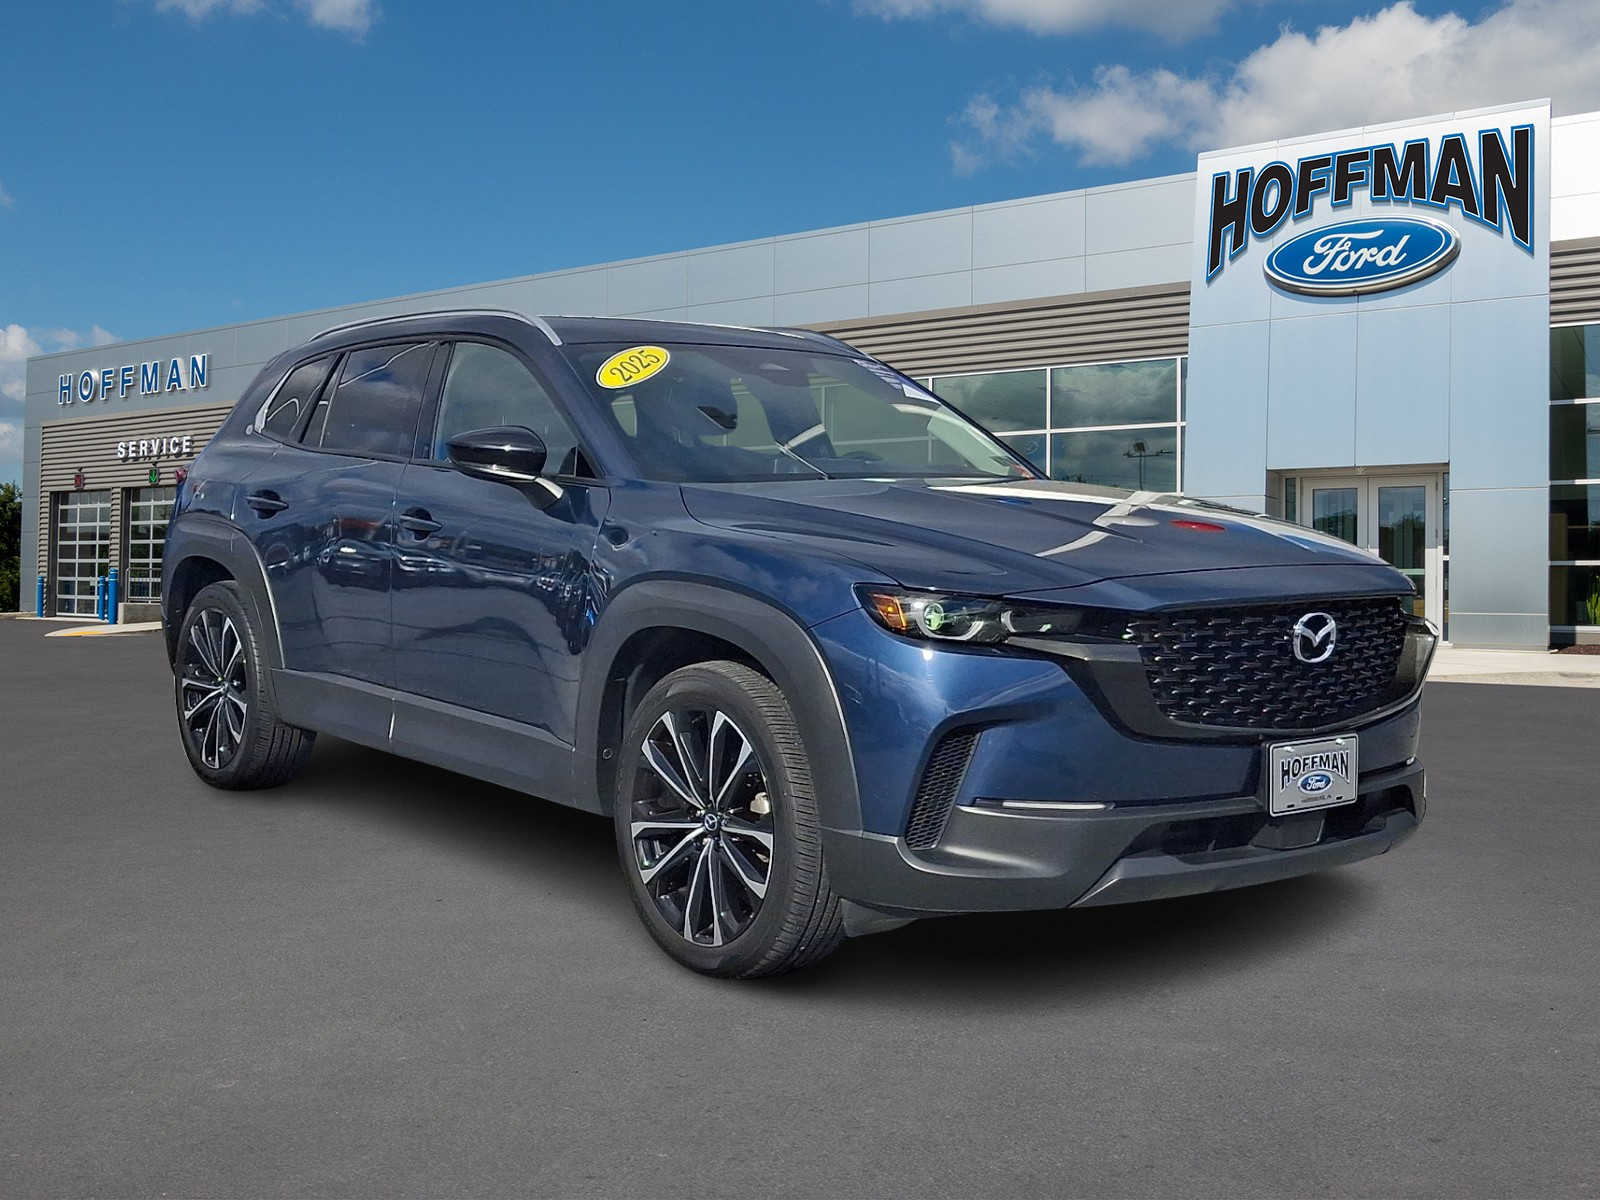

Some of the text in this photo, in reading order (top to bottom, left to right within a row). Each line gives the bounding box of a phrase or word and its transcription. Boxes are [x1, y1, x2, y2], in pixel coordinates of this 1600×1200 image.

[1206, 123, 1534, 282] HOFFMAN
[1303, 229, 1408, 275] Ford
[58, 354, 207, 404] HOFFMAN
[610, 350, 659, 381] 2025
[117, 436, 192, 458] SERVICE
[1281, 750, 1349, 792] HOFFMAN
[1306, 776, 1326, 790] Ford
